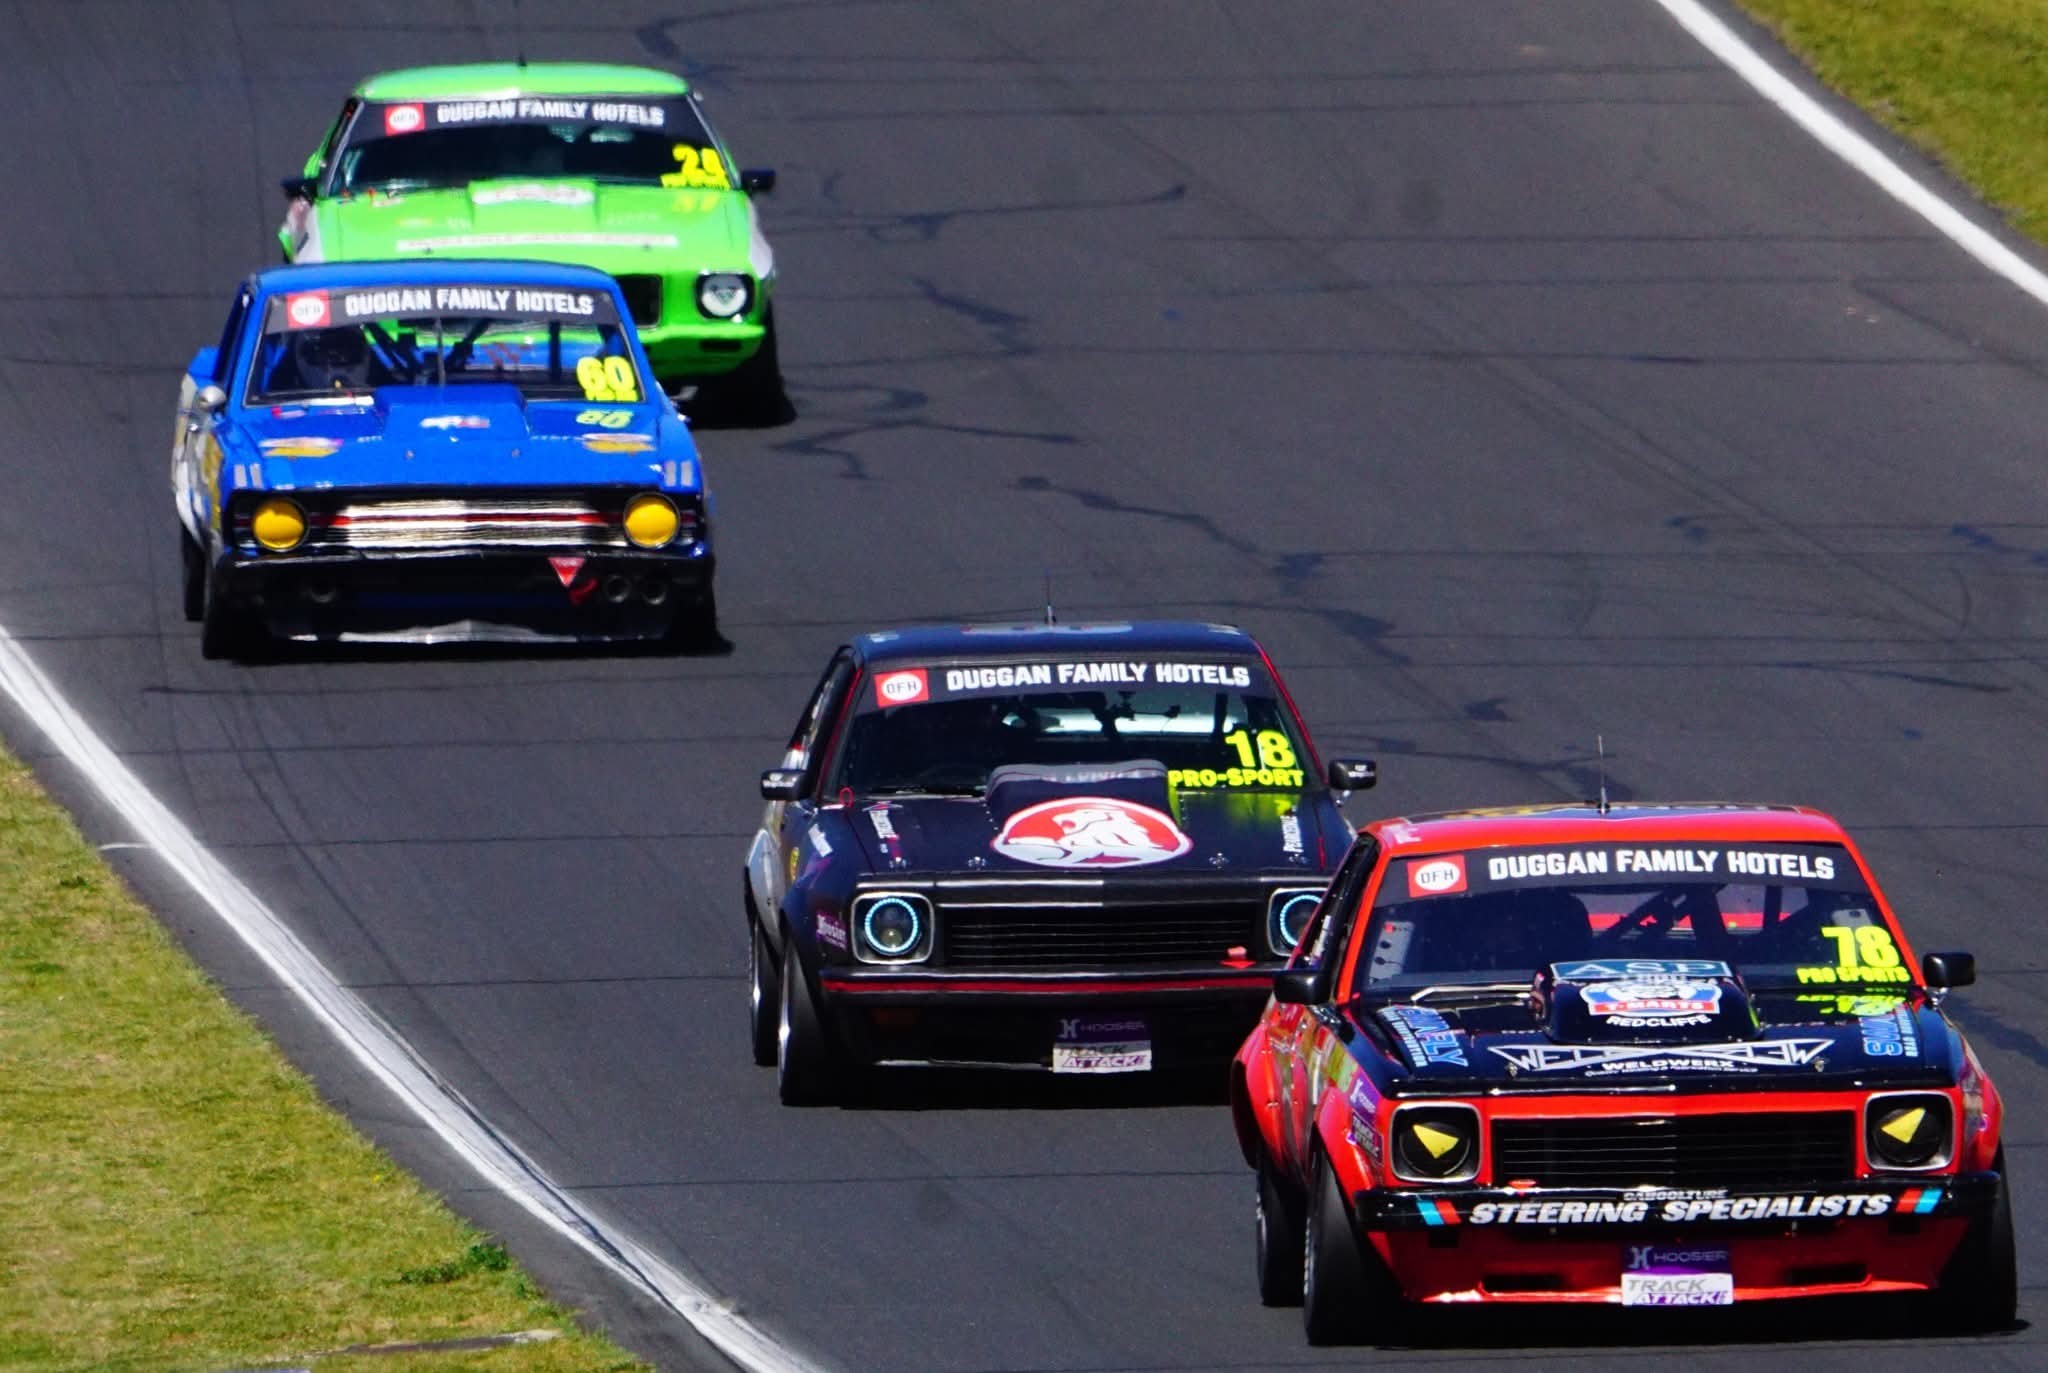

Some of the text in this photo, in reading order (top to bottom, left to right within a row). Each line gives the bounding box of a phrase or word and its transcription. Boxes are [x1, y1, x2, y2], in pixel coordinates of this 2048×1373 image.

[437, 100, 665, 126] DUGGAN FAMILY HOTELS
[346, 288, 594, 316] DUGGAN FAMILY HOTELS
[576, 355, 635, 392] 60
[886, 680, 918, 694] DFH
[946, 663, 1250, 692] DUGGAN FAMILY HOTELS
[1225, 729, 1296, 768] 18
[1168, 767, 1304, 787] PRO-SPORT
[1487, 849, 1835, 881] DUGGAN FAMILY HOTELS
[1420, 869, 1454, 885] DFH
[1821, 925, 1900, 968] 78
[1564, 961, 1716, 976] ASP
[1606, 1014, 1713, 1028] REDCLIFFE
[1602, 1058, 1734, 1071] WELDWERX
[1469, 1193, 1892, 1224] STEERING SPECIALISTS
[1653, 1250, 1729, 1263] HOOSIER
[1628, 1279, 1707, 1292] TRACK
